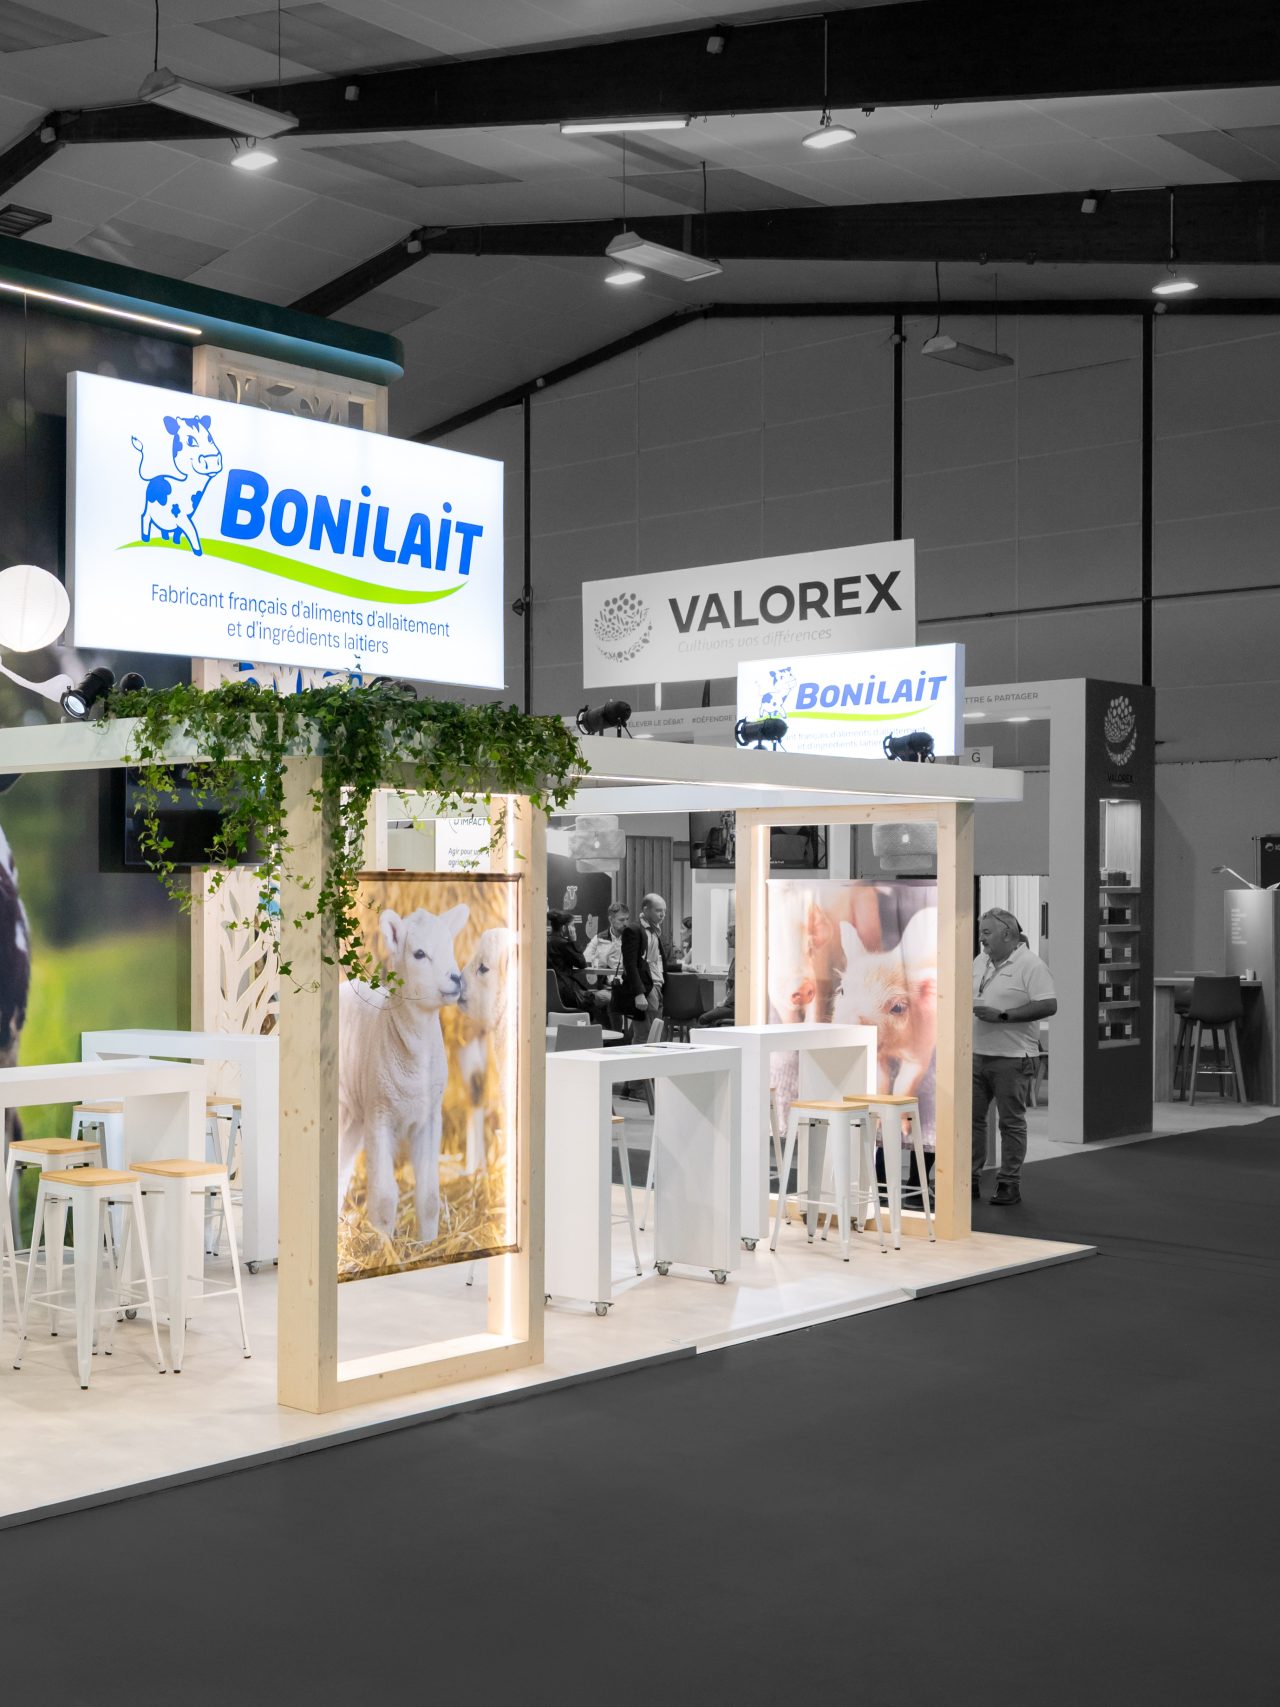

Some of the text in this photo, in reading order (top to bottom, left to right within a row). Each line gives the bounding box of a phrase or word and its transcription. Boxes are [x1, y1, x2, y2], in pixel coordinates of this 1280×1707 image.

[151, 584, 451, 638] Fabricant français d'aliments d'allaitement
[668, 570, 902, 634] VALOREX
[227, 621, 389, 654] et d'ingrédients laitiers
[761, 628, 832, 648] différences
[994, 692, 1039, 702] PARTAGER
[971, 751, 981, 763] G
